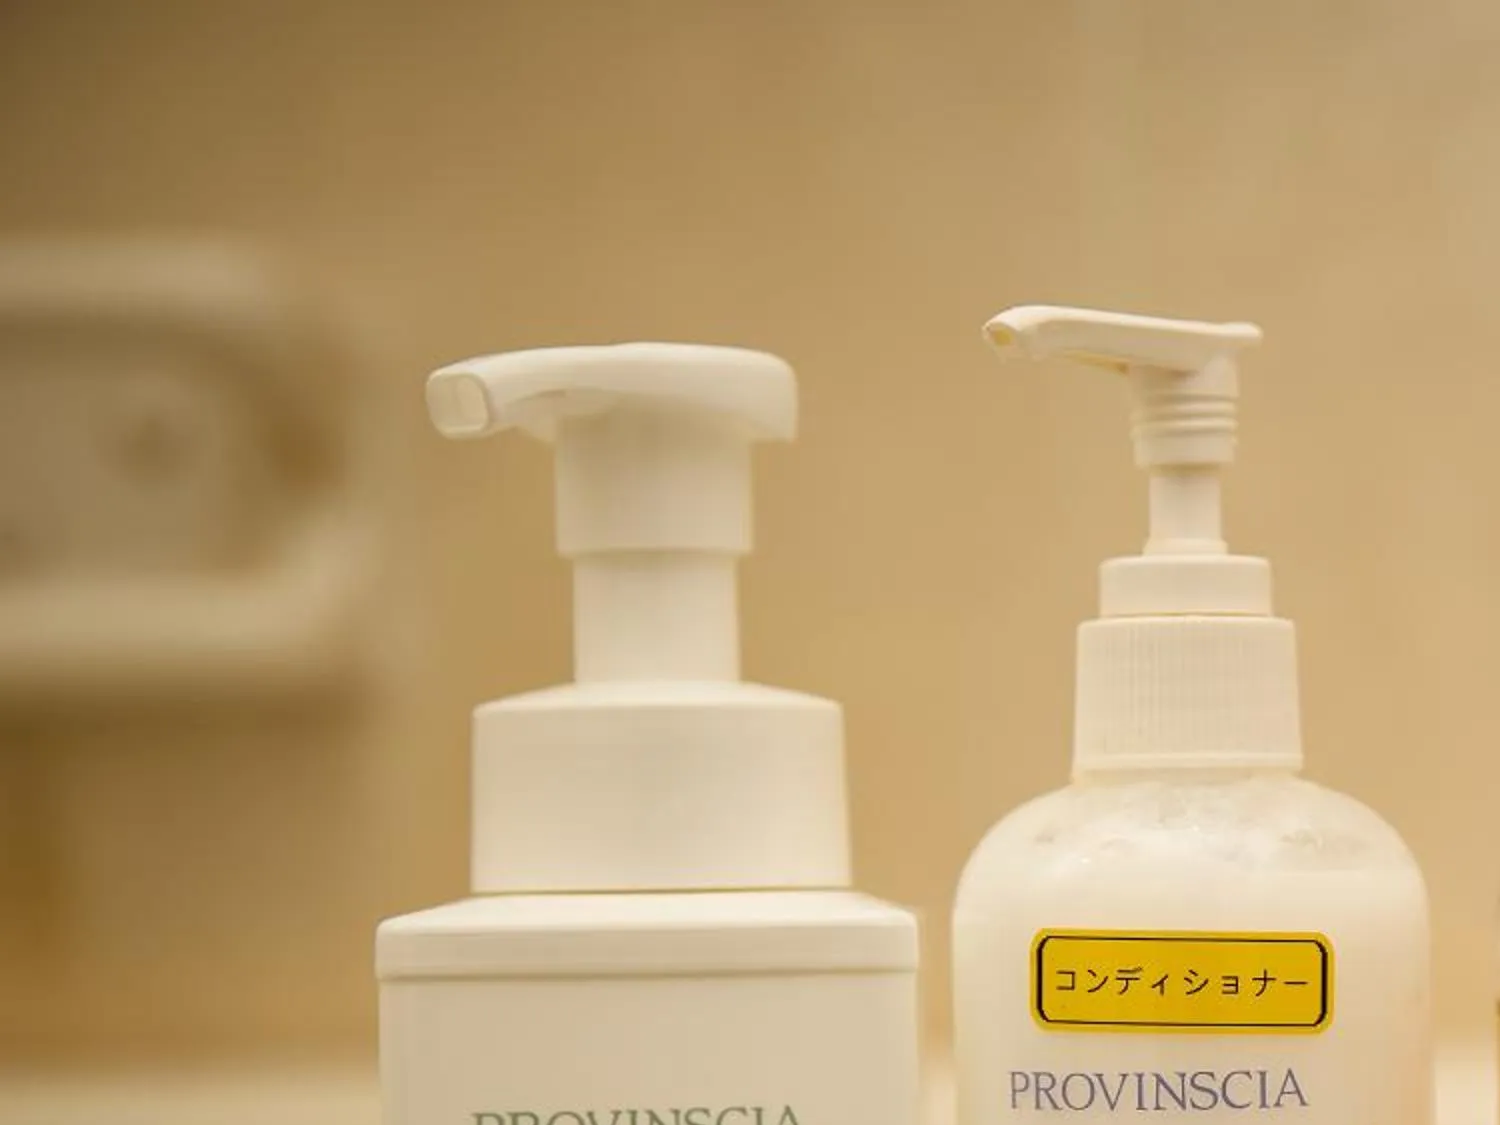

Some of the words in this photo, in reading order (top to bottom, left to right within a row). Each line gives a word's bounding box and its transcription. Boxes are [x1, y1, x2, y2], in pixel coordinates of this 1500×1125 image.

[1056, 966, 1308, 997] コンディショナー
[1009, 1068, 1309, 1111] PROVINSCIA
